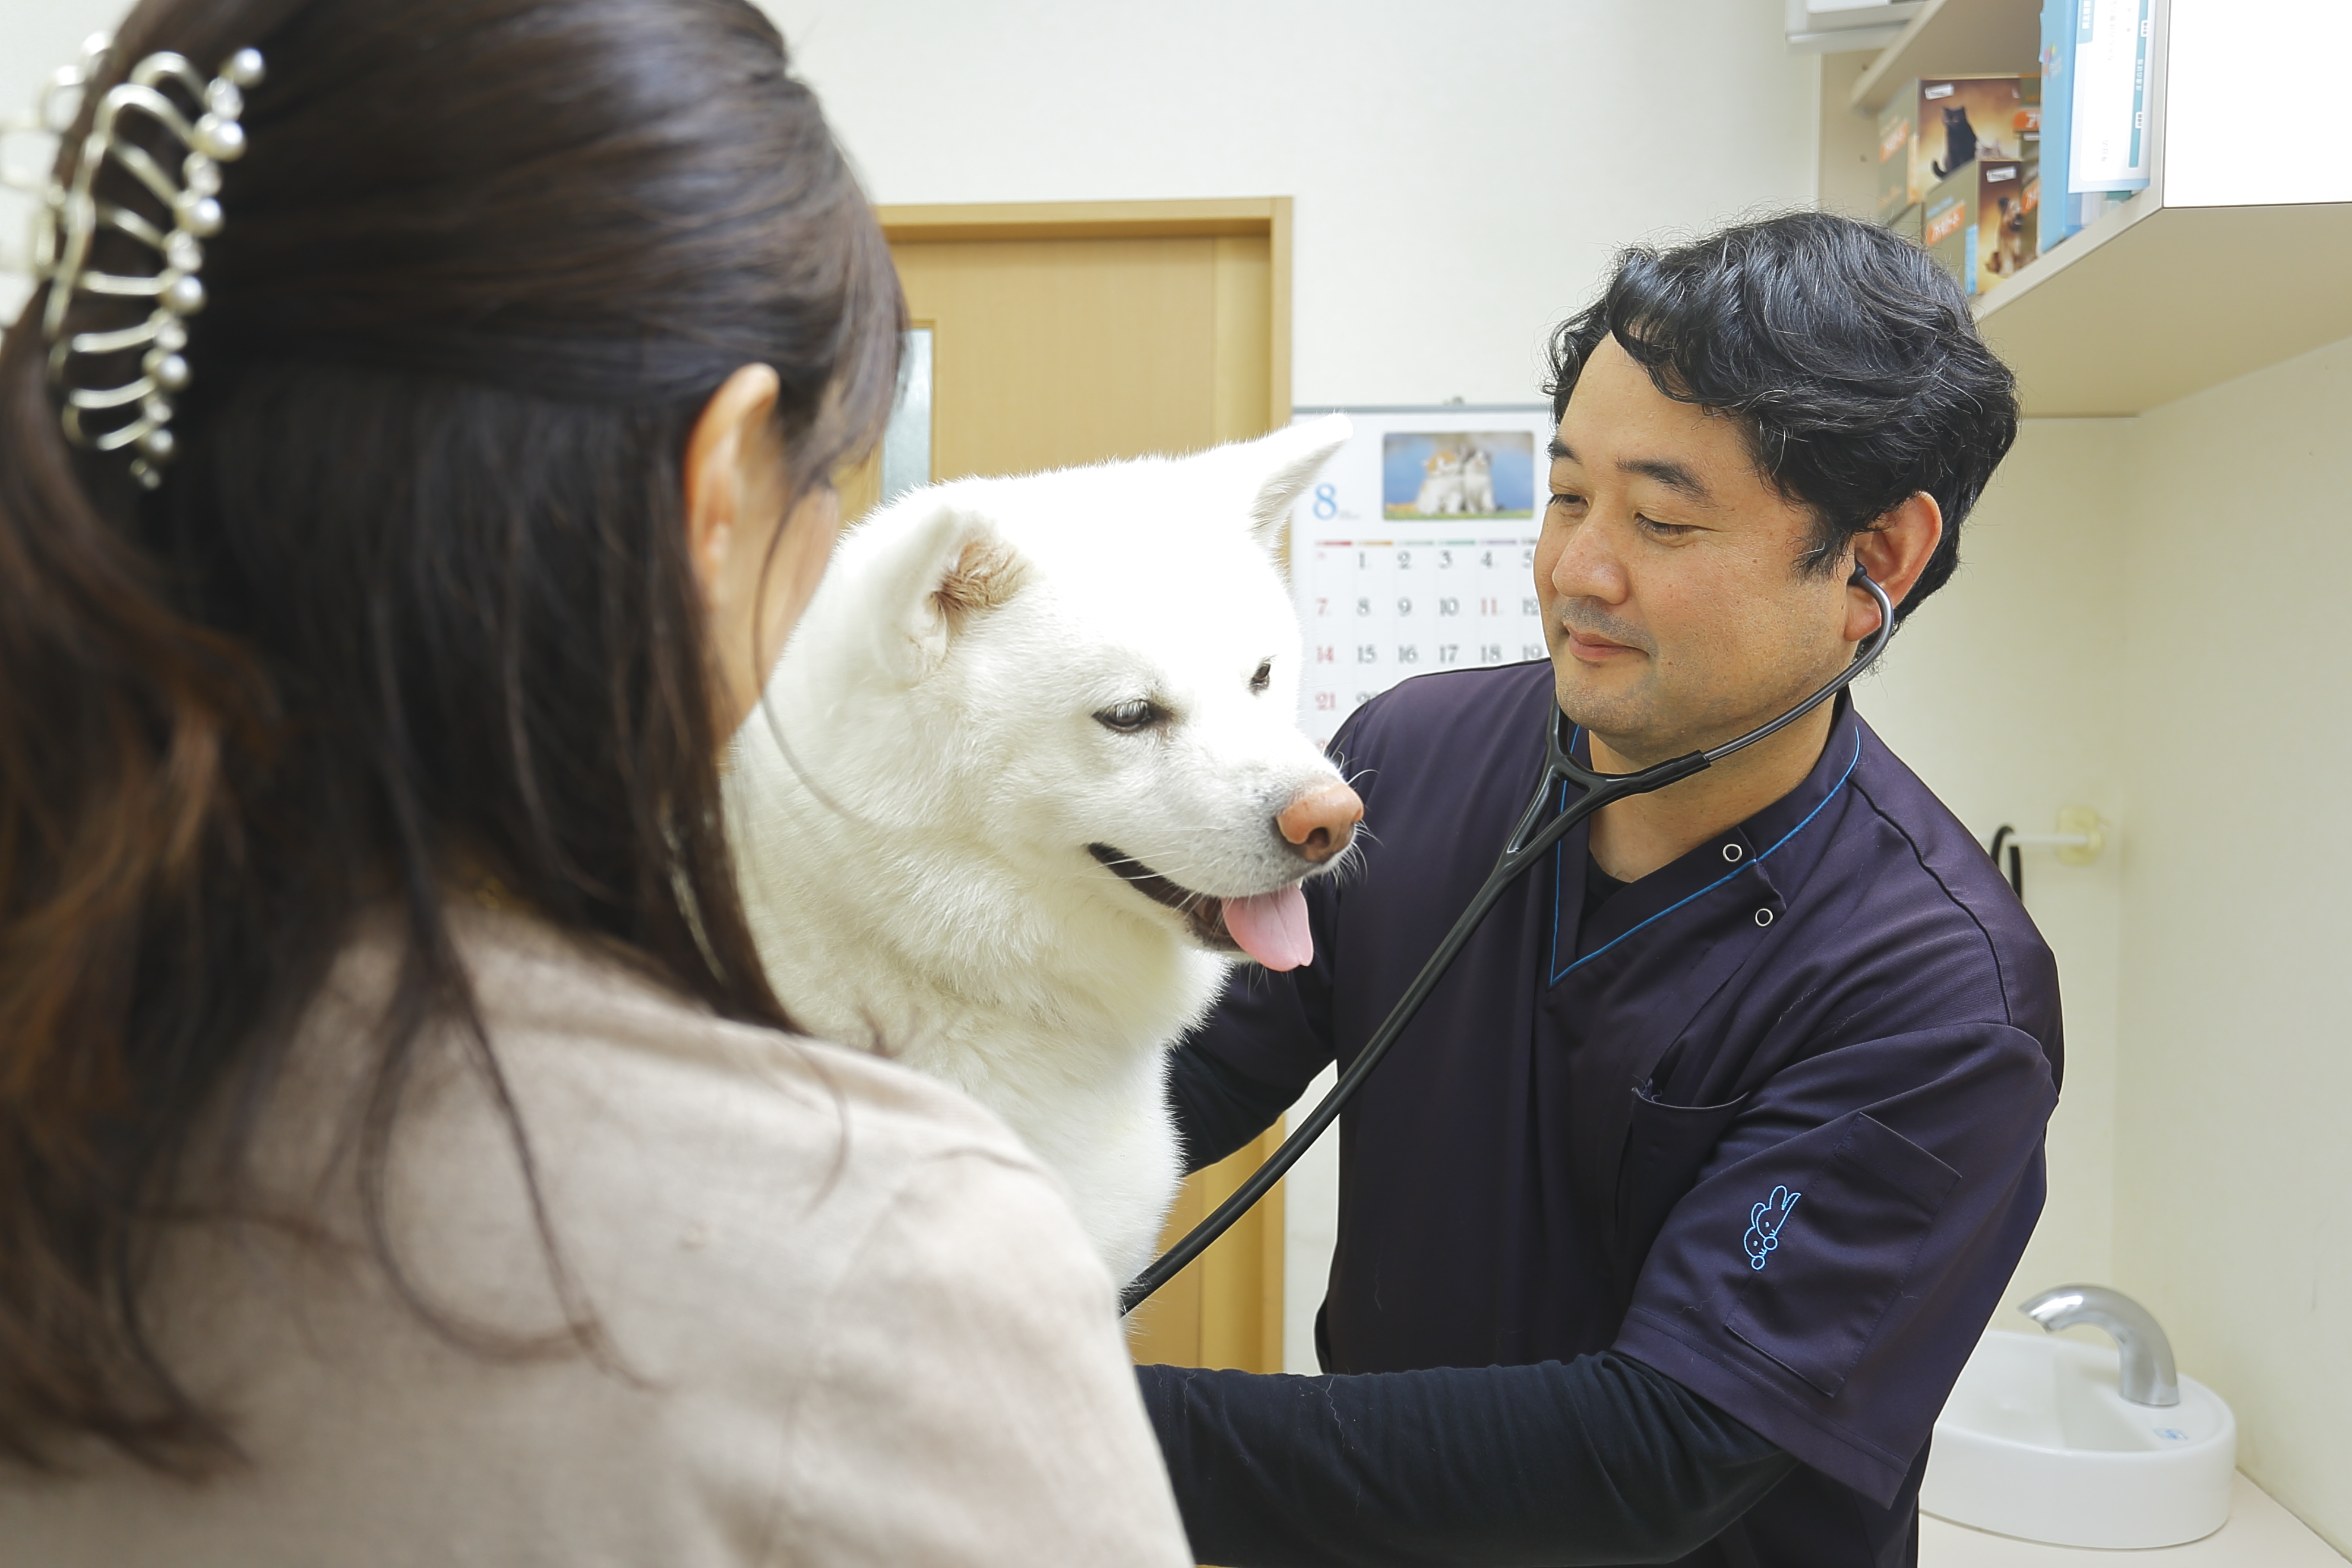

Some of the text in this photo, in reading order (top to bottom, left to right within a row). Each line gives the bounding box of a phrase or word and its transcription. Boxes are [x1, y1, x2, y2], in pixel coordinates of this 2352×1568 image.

[1313, 482, 1337, 521] 8
[1358, 549, 1532, 569] 1 2 3 4 5
[1316, 597, 1539, 616] 7 8 9 10 11 12
[1316, 644, 1542, 663] 14 15 16 17 18 19
[1315, 692, 1336, 710] 21
